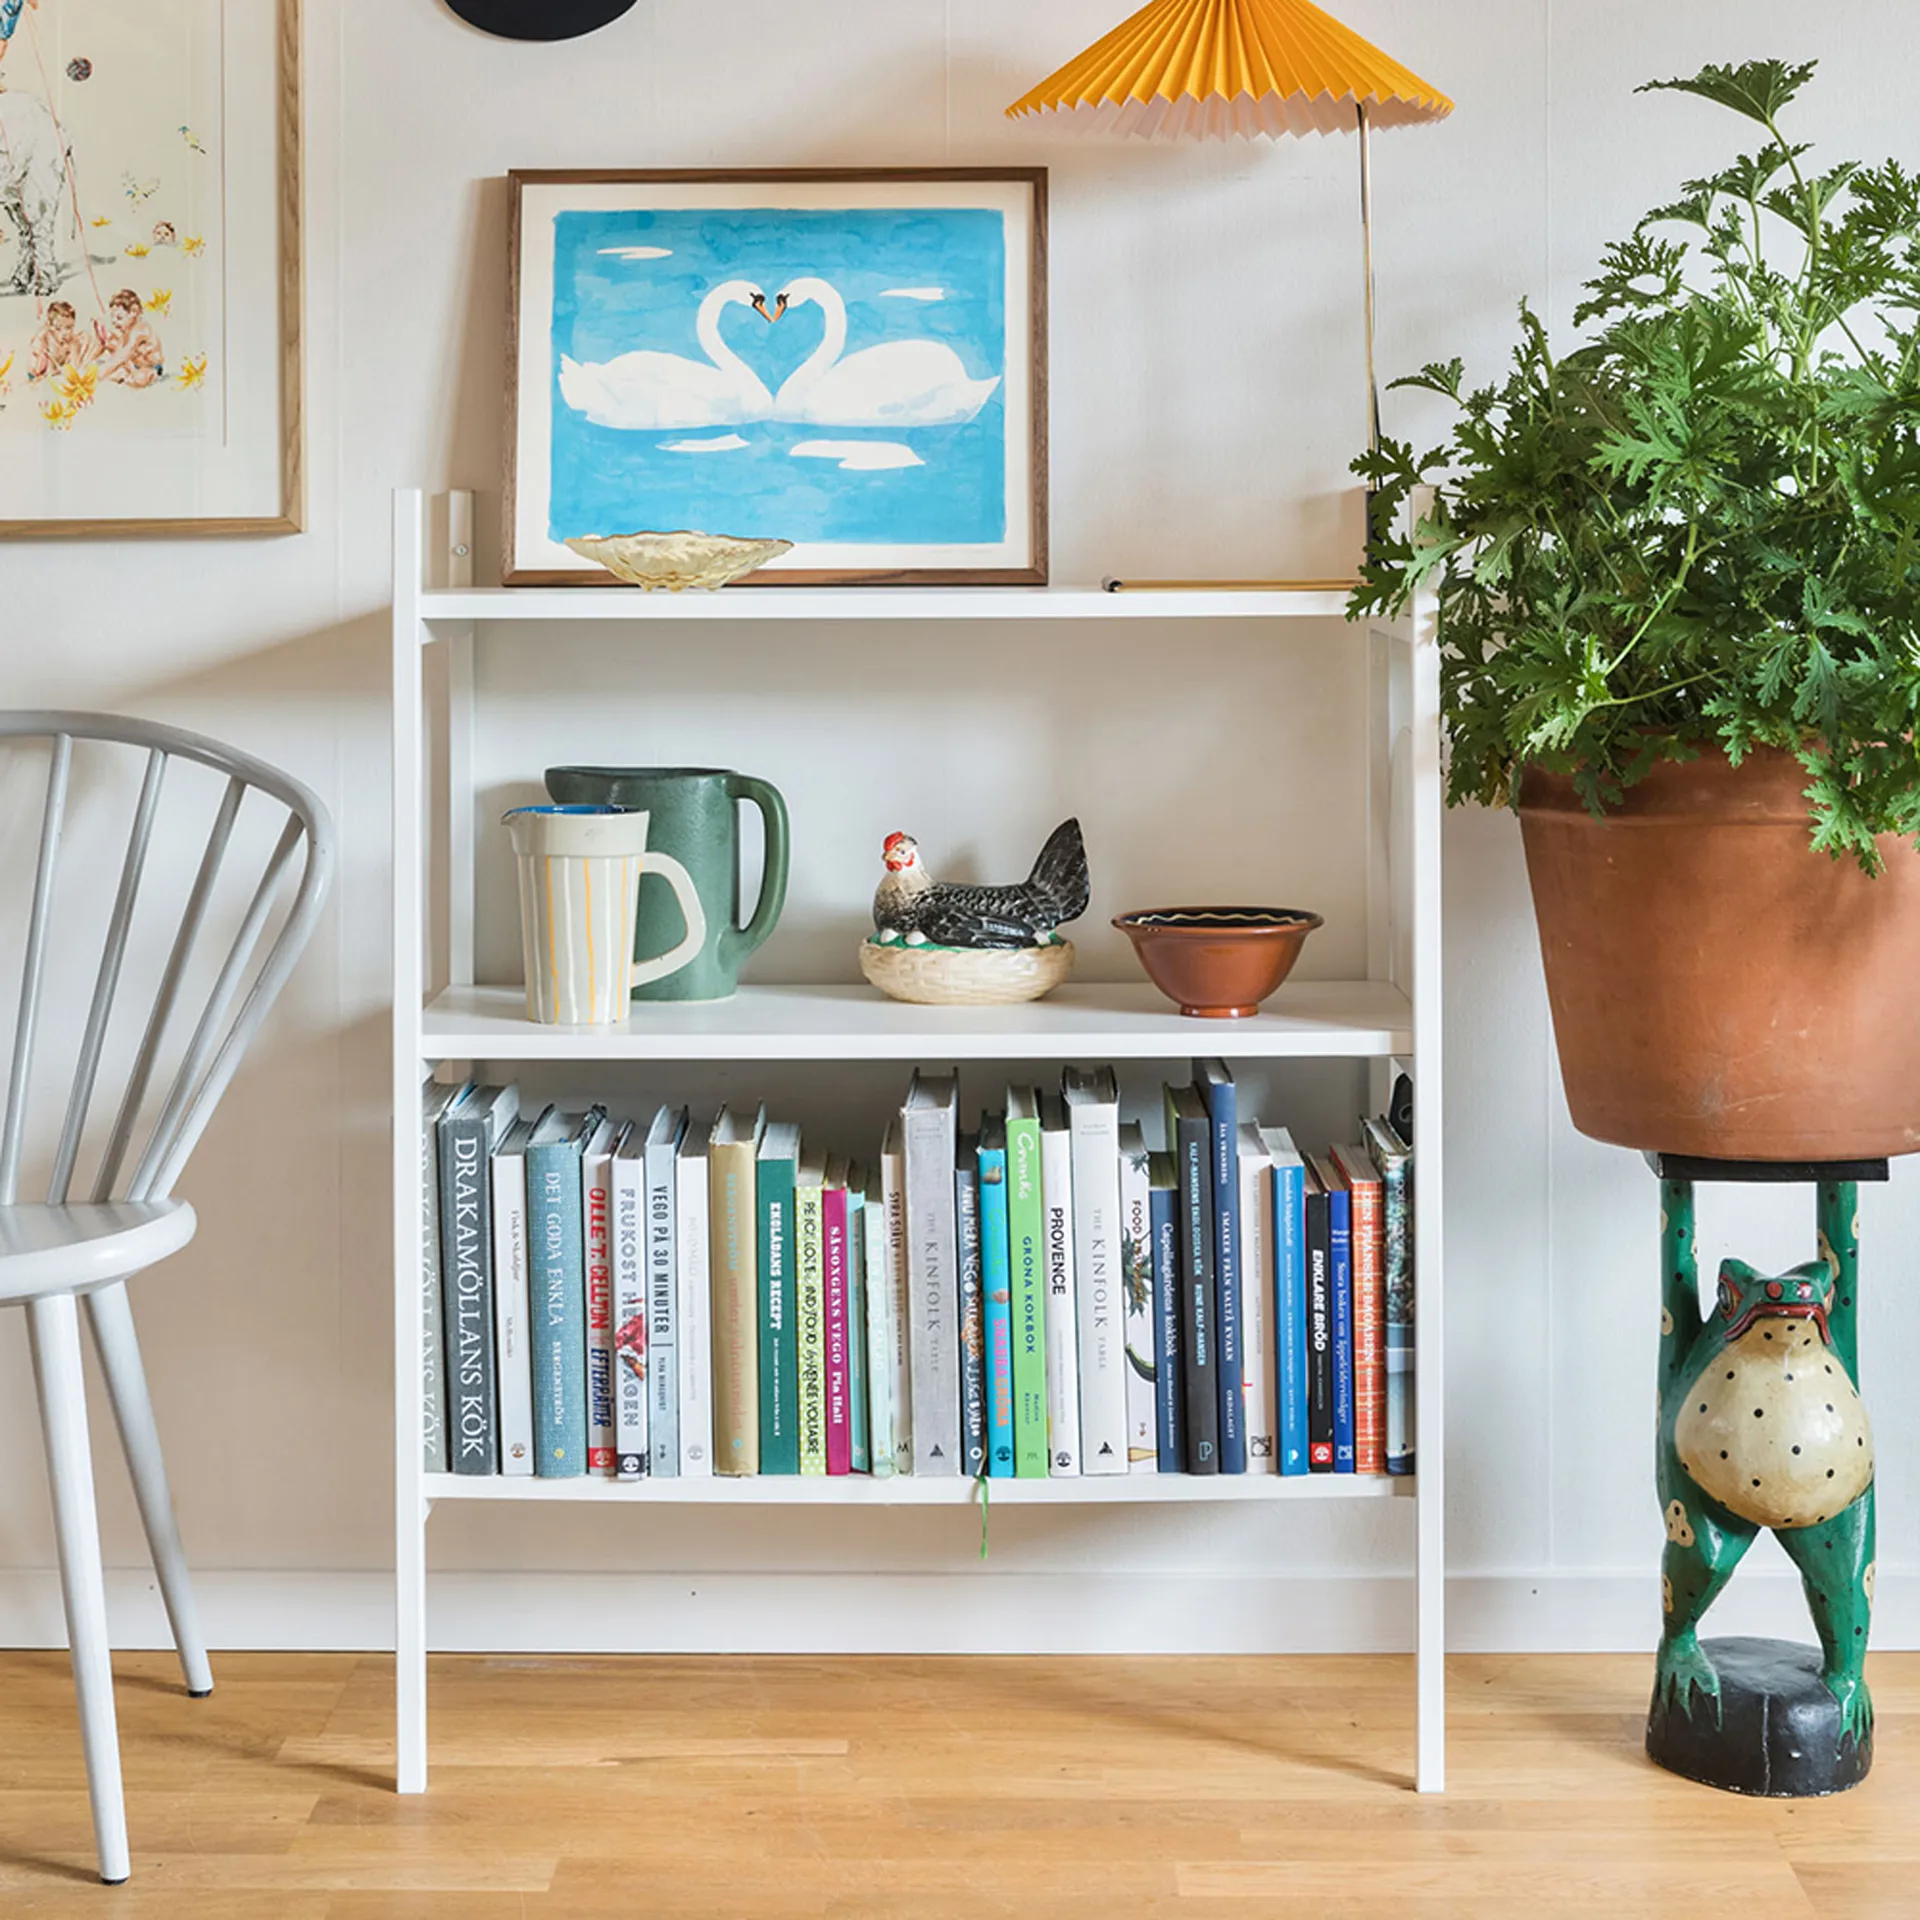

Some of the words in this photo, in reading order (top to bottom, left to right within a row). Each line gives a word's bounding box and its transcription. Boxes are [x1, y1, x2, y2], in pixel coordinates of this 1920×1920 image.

[545, 1172, 561, 1206] DET
[1017, 1132, 1035, 1200] Cranks
[1188, 1142, 1200, 1205] KALF-HANSENS
[590, 1188, 608, 1240] OLLE
[653, 1186, 669, 1220] VEGO
[925, 1211, 936, 1233] THE
[1093, 1209, 1102, 1231] THE
[1131, 1199, 1142, 1235] FOOD
[1361, 1191, 1374, 1221] DEN
[546, 1212, 562, 1260] GODA
[590, 1243, 607, 1259] T.
[620, 1188, 636, 1284] FRUKOST
[653, 1226, 671, 1242] PÅ
[769, 1202, 783, 1277] EKOLÅDANS
[962, 1216, 977, 1248] MERA
[1050, 1207, 1067, 1295] PROVENCE
[1190, 1206, 1202, 1258] EKOLOGISKA
[1221, 1211, 1232, 1254] SMAKER
[1361, 1223, 1375, 1288] FRANSKE
[422, 1133, 436, 1382] ÖLLANS
[454, 1137, 484, 1385] DRAKAMÖLLANS
[654, 1250, 669, 1267] 30
[828, 1226, 842, 1319] SÄSONGENS
[962, 1253, 979, 1293] VEGO
[1022, 1236, 1035, 1288] GRÖNA
[1160, 1221, 1176, 1312] Capellagårdens
[1192, 1259, 1204, 1276] KÖK
[1222, 1259, 1235, 1286] FRÅN
[1312, 1248, 1326, 1311] ENKLARE
[1337, 1262, 1347, 1287] Stora
[547, 1268, 565, 1326] ENKLA
[590, 1265, 609, 1329] CELLTON
[654, 1273, 670, 1334] MINUTER
[769, 1280, 782, 1331] RECEPT
[925, 1241, 941, 1331] KINFOLK
[1092, 1239, 1108, 1328] KINFOLK
[1194, 1284, 1204, 1306] RUNE
[1223, 1290, 1235, 1322] SALTÅ
[1338, 1289, 1348, 1320] boken
[829, 1323, 842, 1364] VEGO
[1023, 1293, 1036, 1354] KOKBOK
[1164, 1314, 1177, 1357] kokbok
[1195, 1308, 1207, 1366] KALF-HANSEN
[1224, 1325, 1234, 1362] KVARN
[1313, 1311, 1328, 1352] BRÖD
[1338, 1321, 1346, 1338] om
[1362, 1291, 1376, 1362] BAGAREN
[930, 1337, 939, 1373] TABLE
[992, 1318, 1011, 1428] SNABBAGRÖNA
[1097, 1336, 1107, 1370] TABLE
[551, 1341, 564, 1425] BERGENSTRÖM
[803, 1362, 819, 1398] RENÉE
[830, 1371, 842, 1393] Pia
[460, 1395, 487, 1458] KÖK
[806, 1400, 819, 1454] VOLTAIRE
